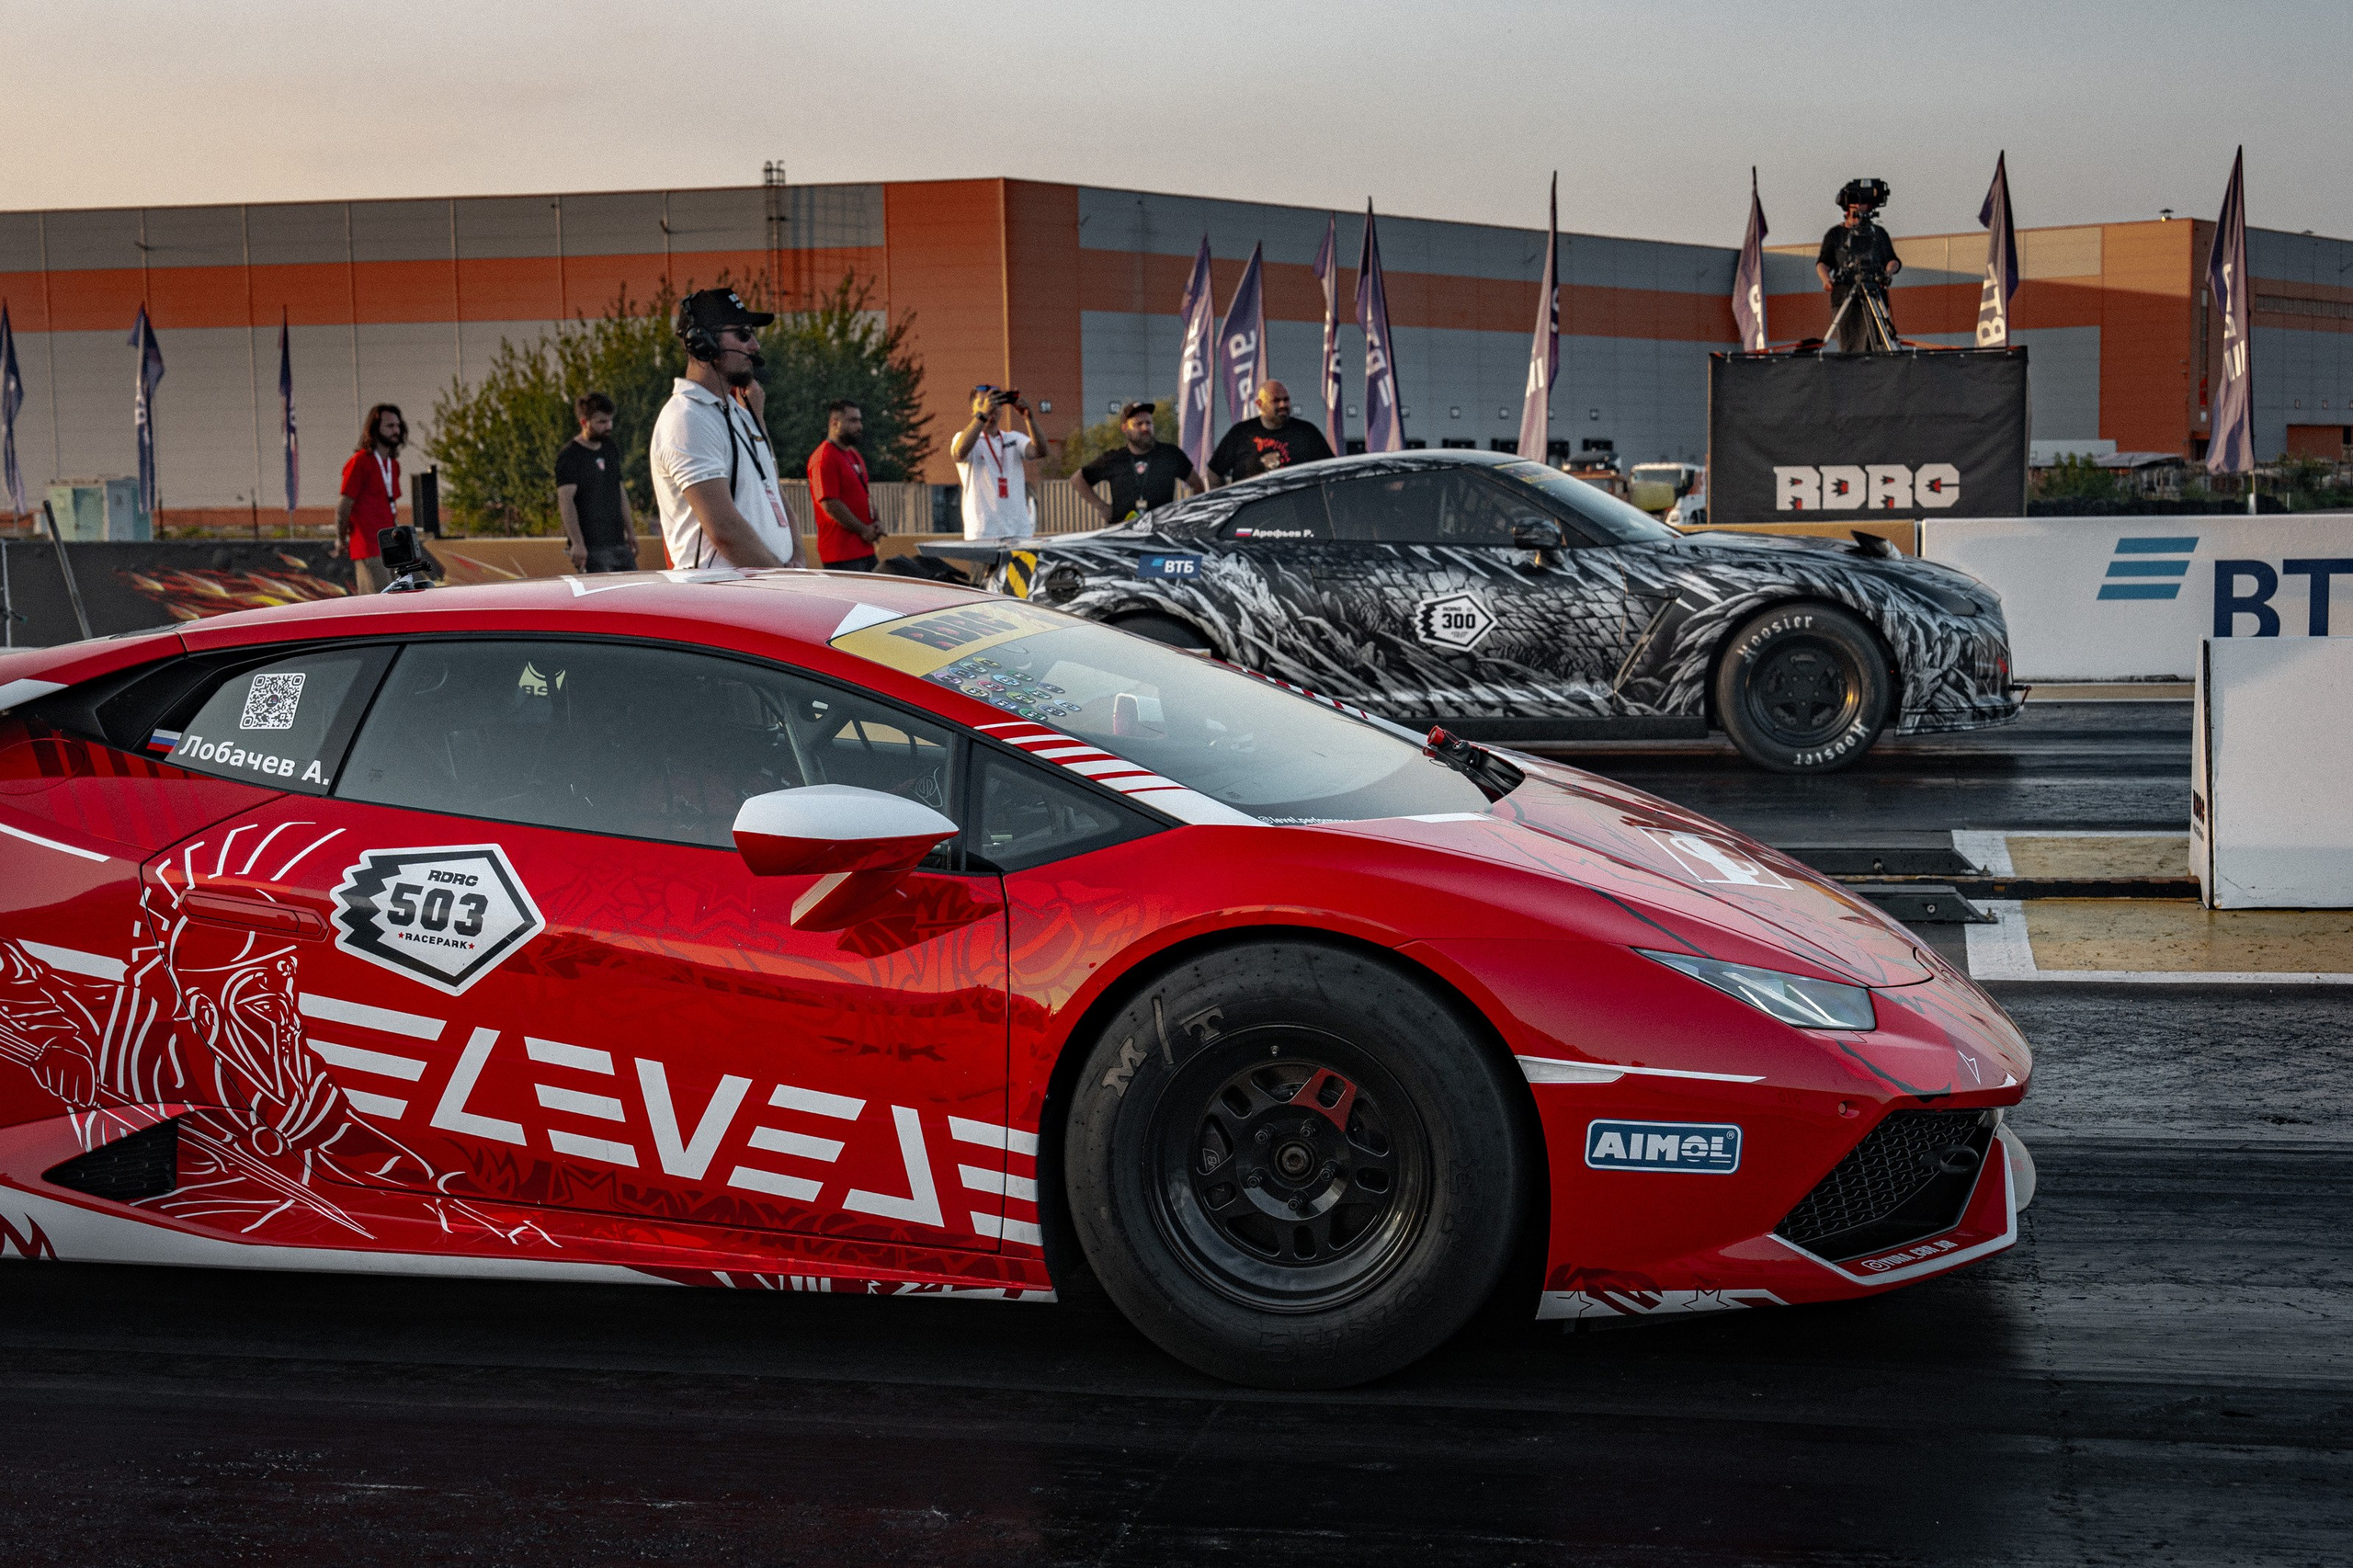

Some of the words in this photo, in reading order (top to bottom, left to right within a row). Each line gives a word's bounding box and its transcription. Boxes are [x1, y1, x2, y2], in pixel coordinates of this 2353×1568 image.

[1773, 463, 1961, 510] RDRC
[1164, 560, 1195, 574] ВТБ
[1441, 613, 1476, 629] 300
[1735, 614, 1813, 664] Hoosier
[178, 735, 296, 778] Лобачев
[301, 759, 330, 786] А.
[1793, 716, 1870, 765] Hoosier
[427, 869, 479, 887] RDRC
[387, 882, 489, 937] 503
[404, 932, 468, 949] RACEPARK
